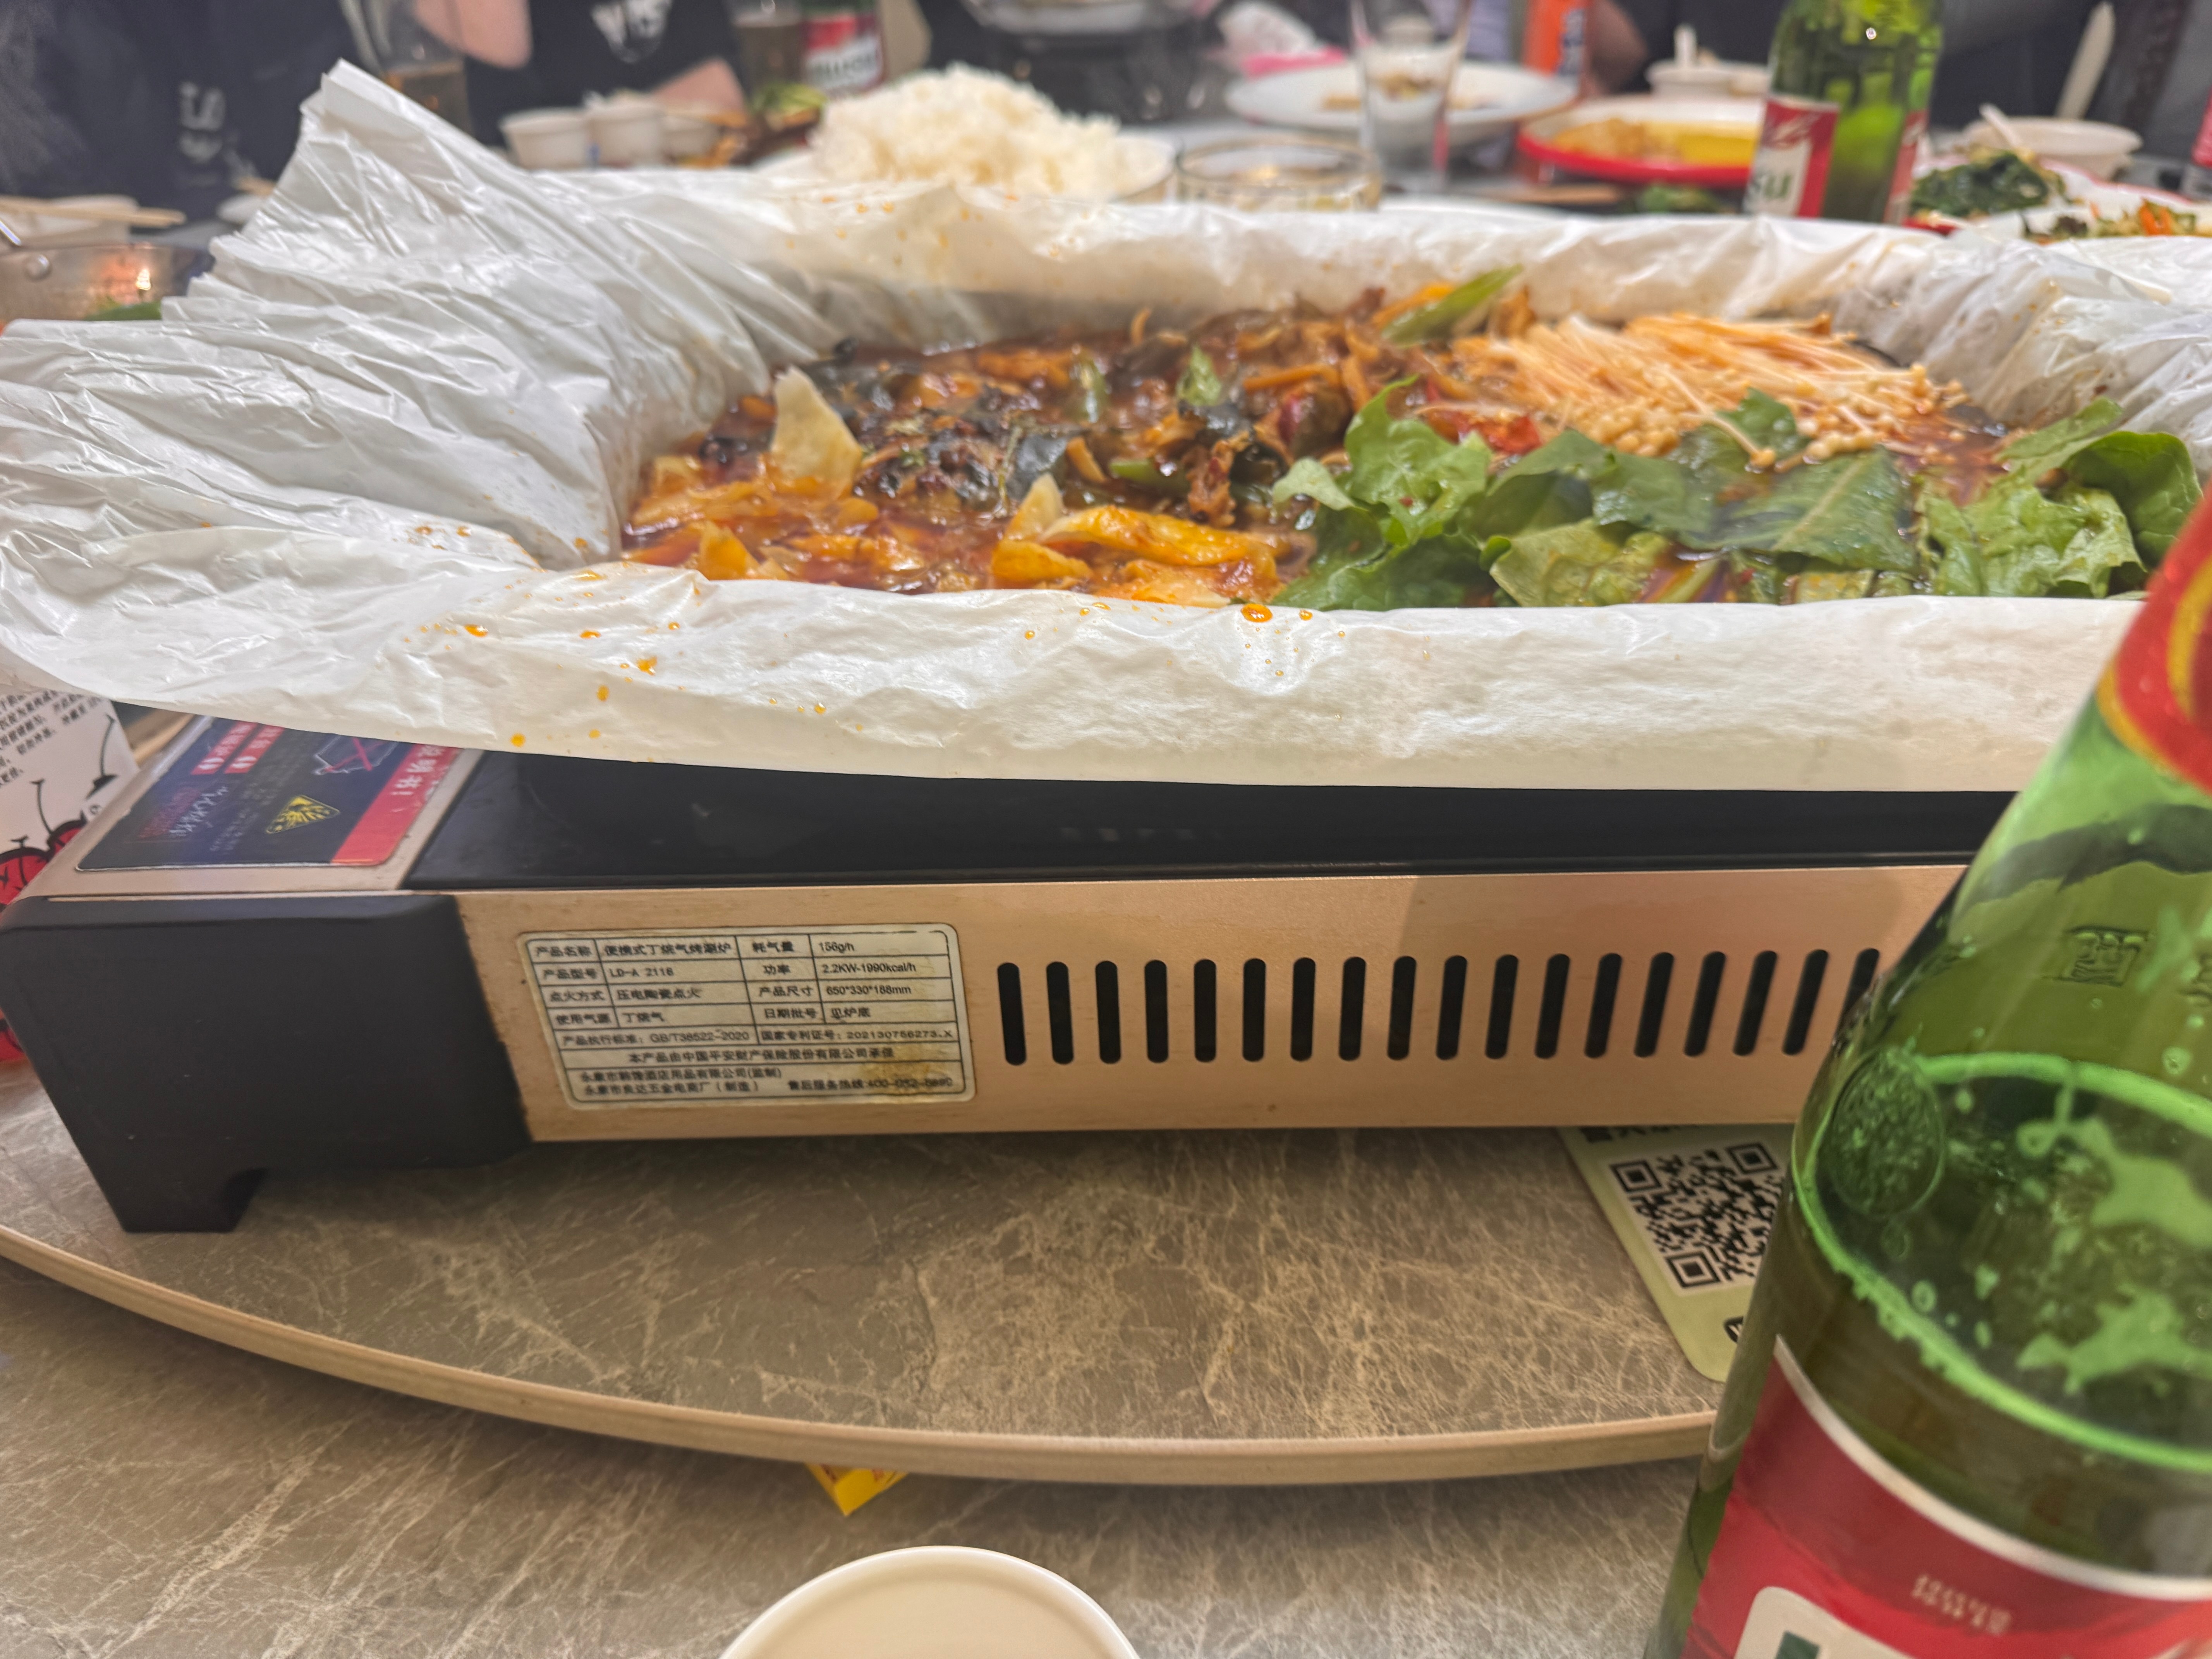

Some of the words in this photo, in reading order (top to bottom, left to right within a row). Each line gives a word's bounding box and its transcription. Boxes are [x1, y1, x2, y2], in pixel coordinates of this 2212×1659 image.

[536, 945, 592, 957] 产品名称
[752, 941, 794, 953] 耗气量
[543, 968, 597, 980] 产品型号
[610, 969, 639, 978] LD-A
[763, 964, 791, 975] 功率
[550, 990, 606, 1002] 点火方式
[759, 986, 814, 997] 产品尺寸
[555, 1012, 612, 1024] 使用气源
[764, 1008, 818, 1019] 日期批号
